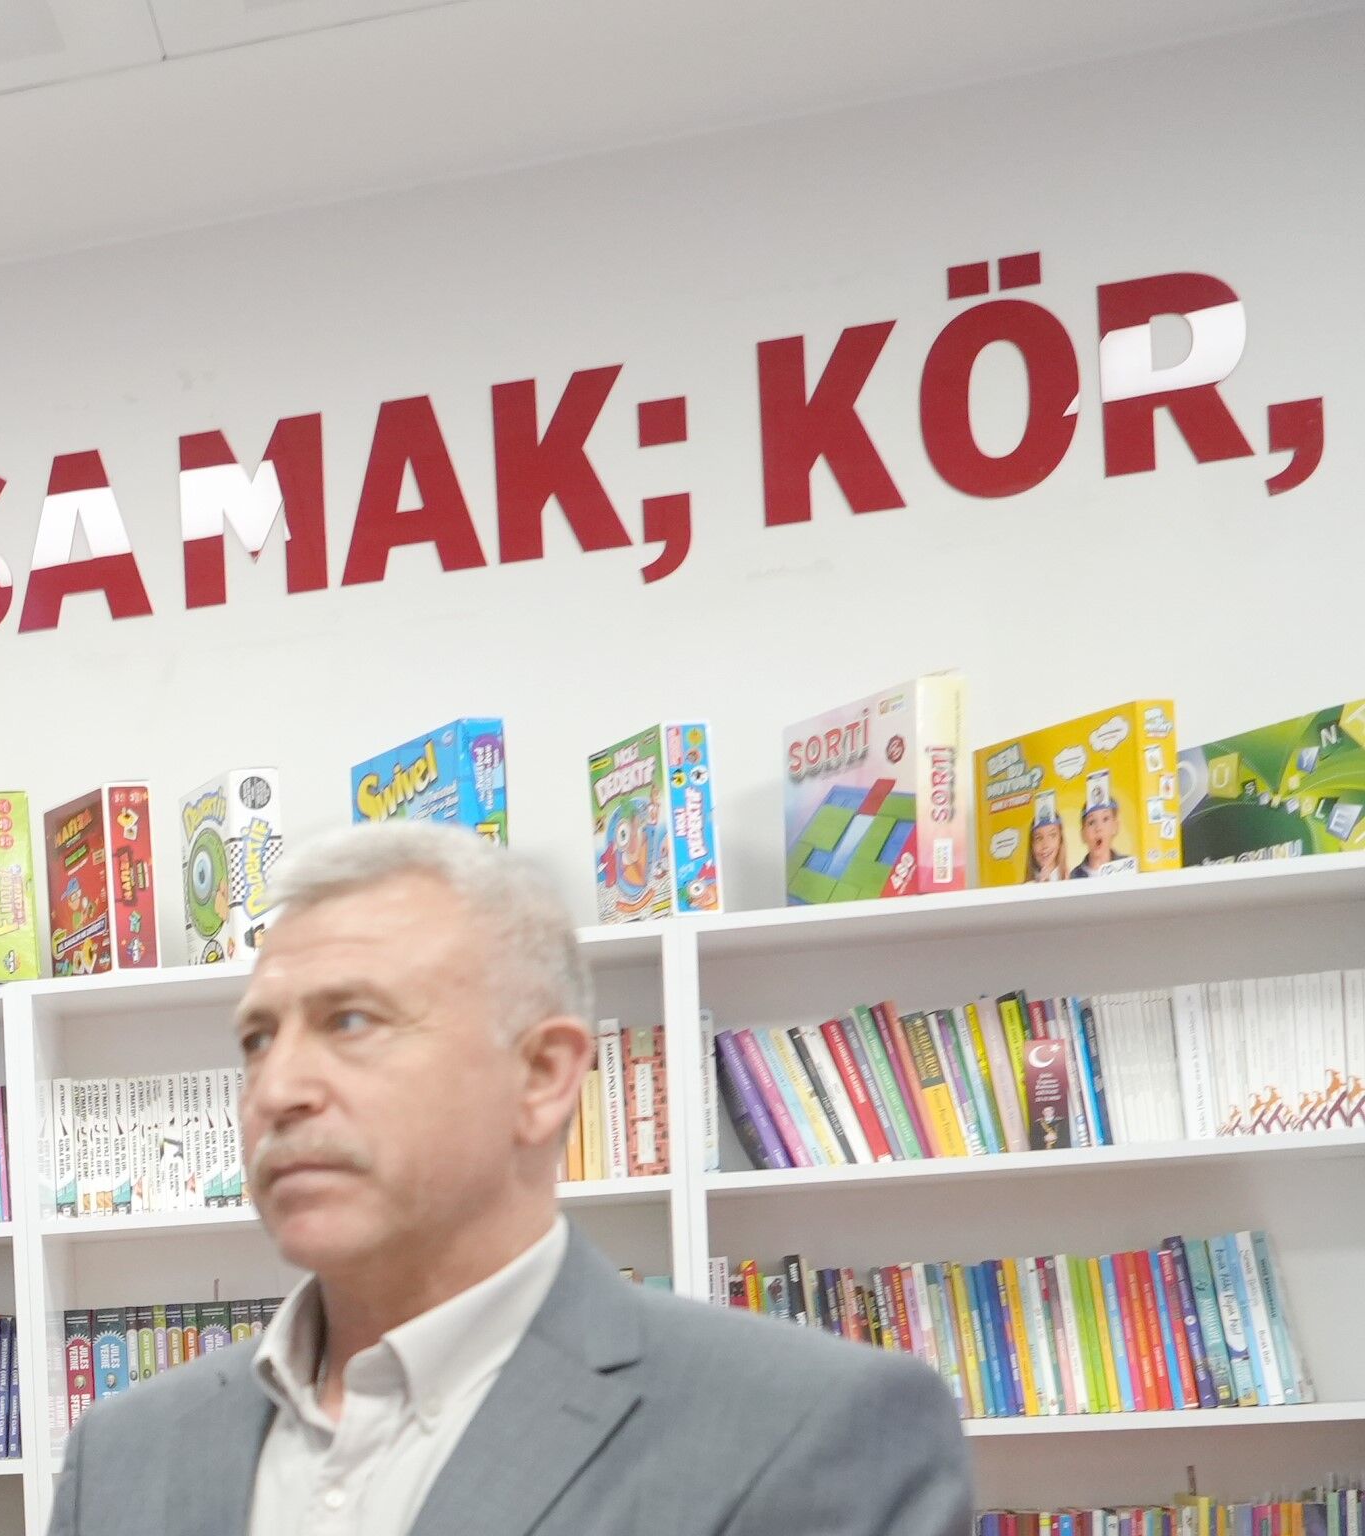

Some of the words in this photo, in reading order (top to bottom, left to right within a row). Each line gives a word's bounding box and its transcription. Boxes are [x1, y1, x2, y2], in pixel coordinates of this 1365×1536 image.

[757, 251, 1325, 528] KÖR,
[357, 739, 439, 826] Swivel
[69, 1344, 80, 1371] VERNE
[79, 1343, 90, 1370] JULES
[100, 1343, 111, 1370] VERNE
[110, 1342, 120, 1369] JULES
